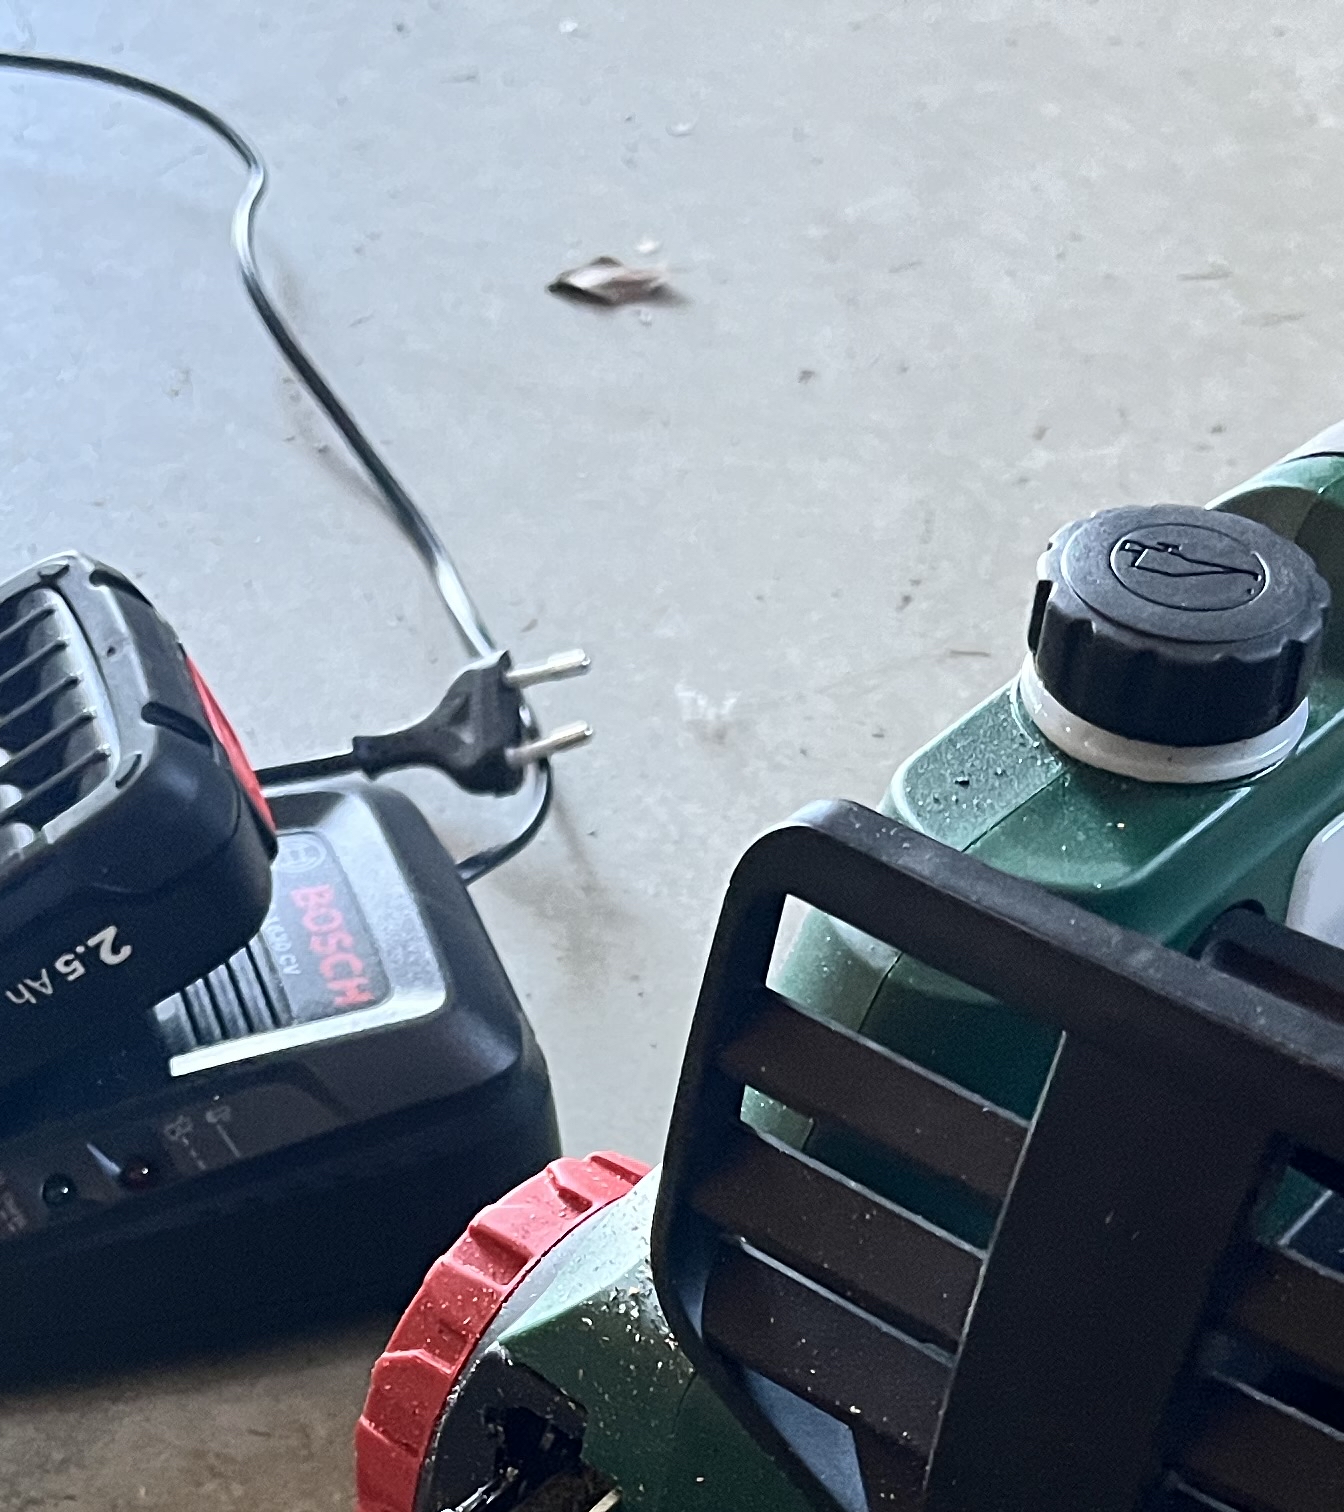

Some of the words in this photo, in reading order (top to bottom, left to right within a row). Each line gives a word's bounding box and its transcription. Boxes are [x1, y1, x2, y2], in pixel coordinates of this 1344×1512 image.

[54, 925, 133, 981] 2.5
[290, 884, 375, 1005] BOSCH
[5, 968, 54, 1004] Ah
